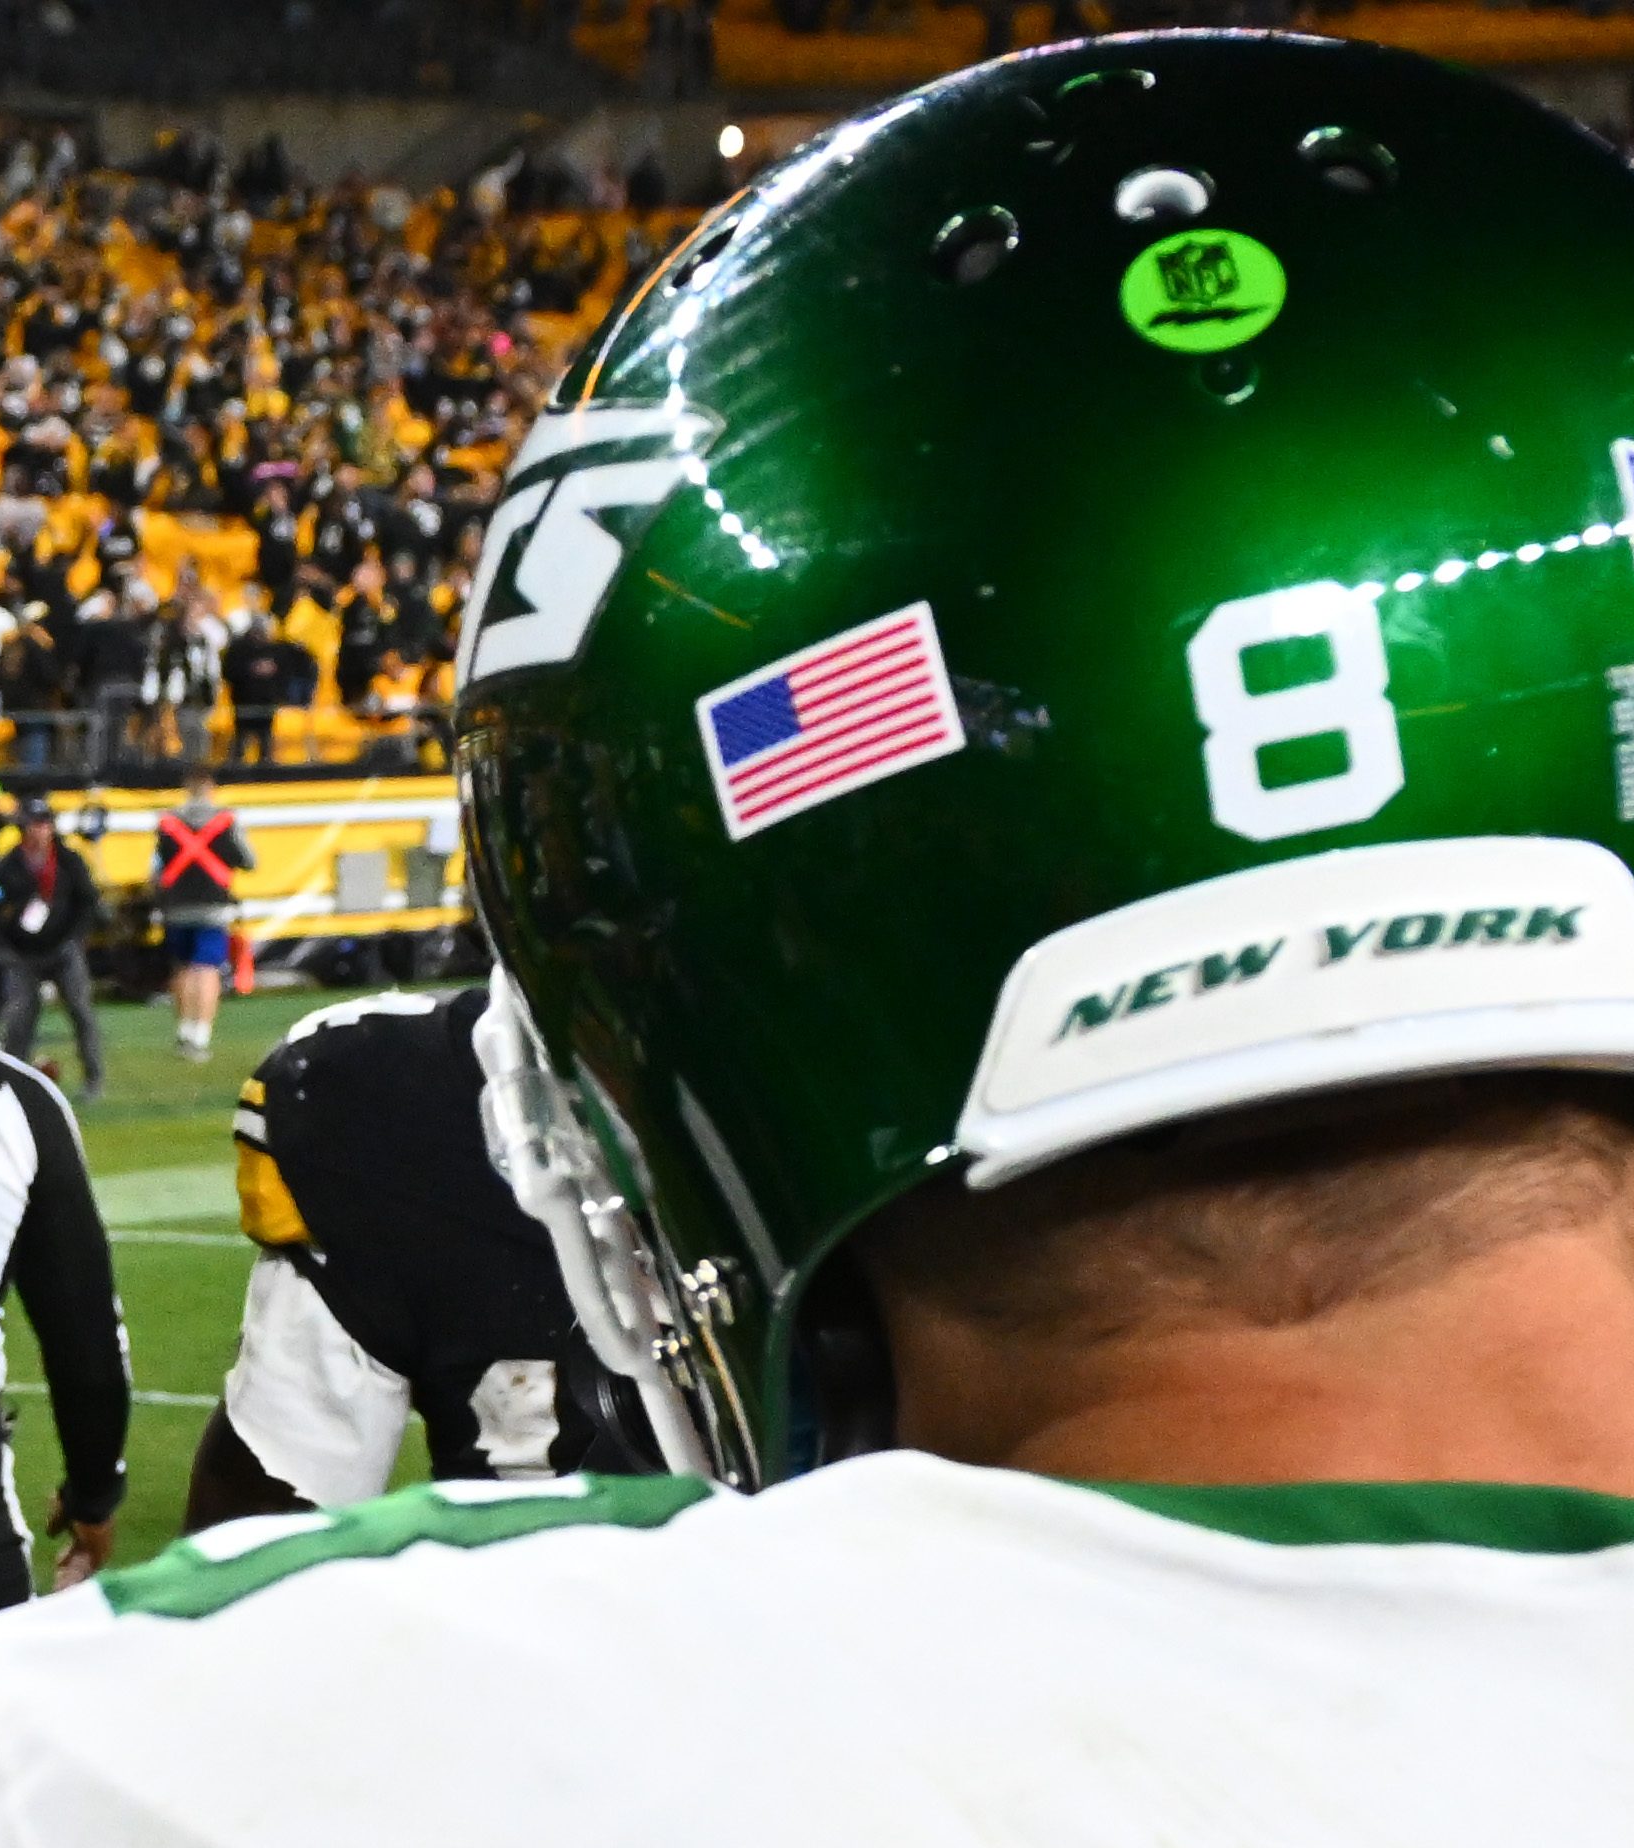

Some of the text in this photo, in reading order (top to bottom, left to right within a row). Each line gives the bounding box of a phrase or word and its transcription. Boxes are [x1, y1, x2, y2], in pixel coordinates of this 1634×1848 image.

[1187, 580, 1405, 842] 8
[1049, 904, 1591, 1045] NEW YORK
